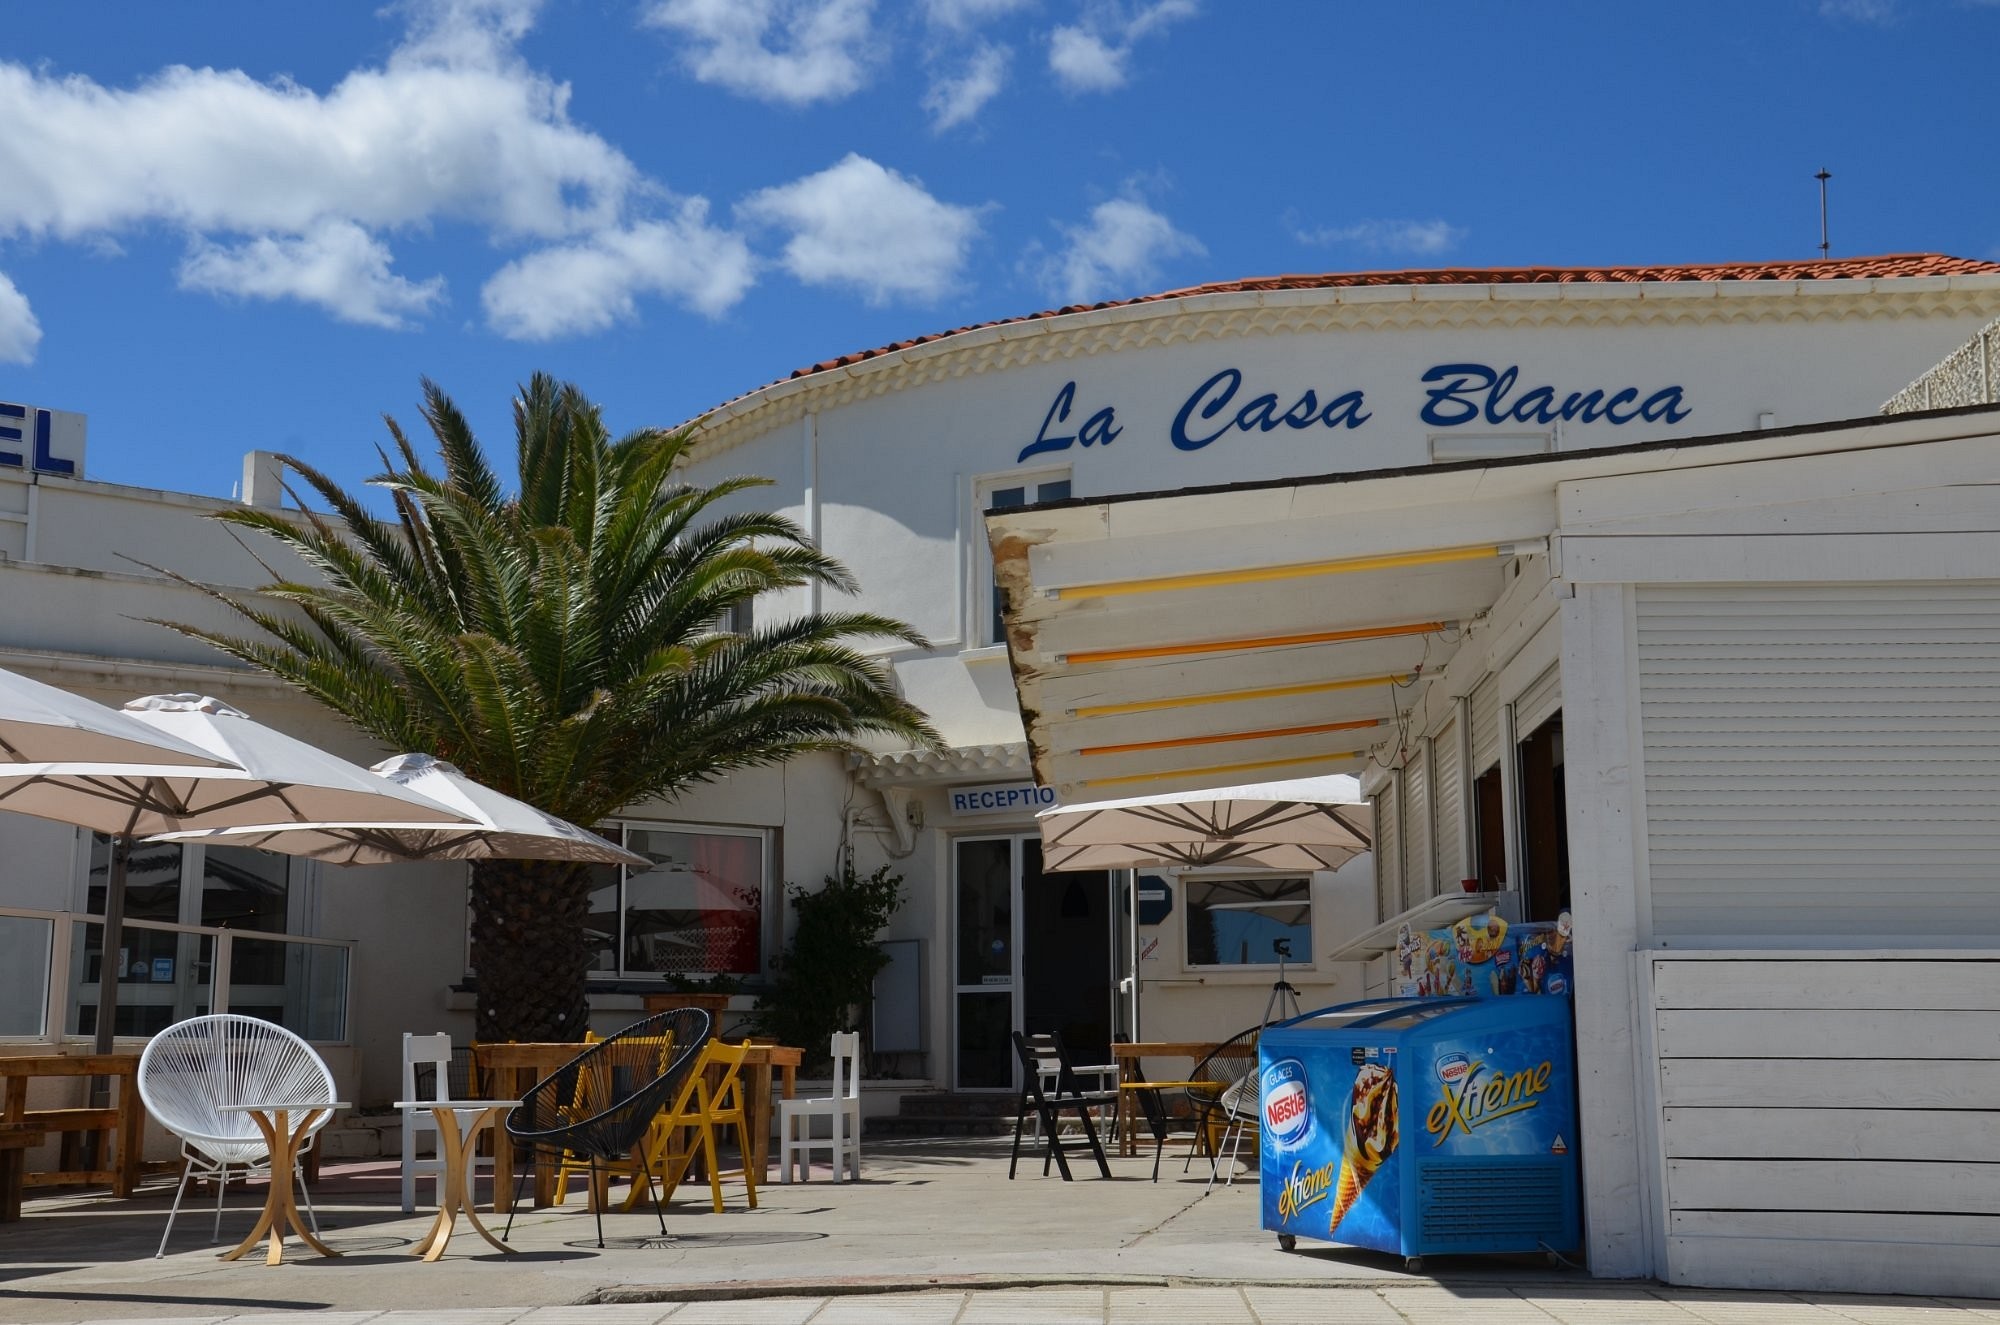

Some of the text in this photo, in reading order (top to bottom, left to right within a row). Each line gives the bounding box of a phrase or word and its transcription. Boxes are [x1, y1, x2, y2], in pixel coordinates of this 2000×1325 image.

[1017, 363, 1693, 463] La Casa Blanca
[954, 787, 1055, 810] RECEPTIO
[1269, 1066, 1293, 1086] GLACES
